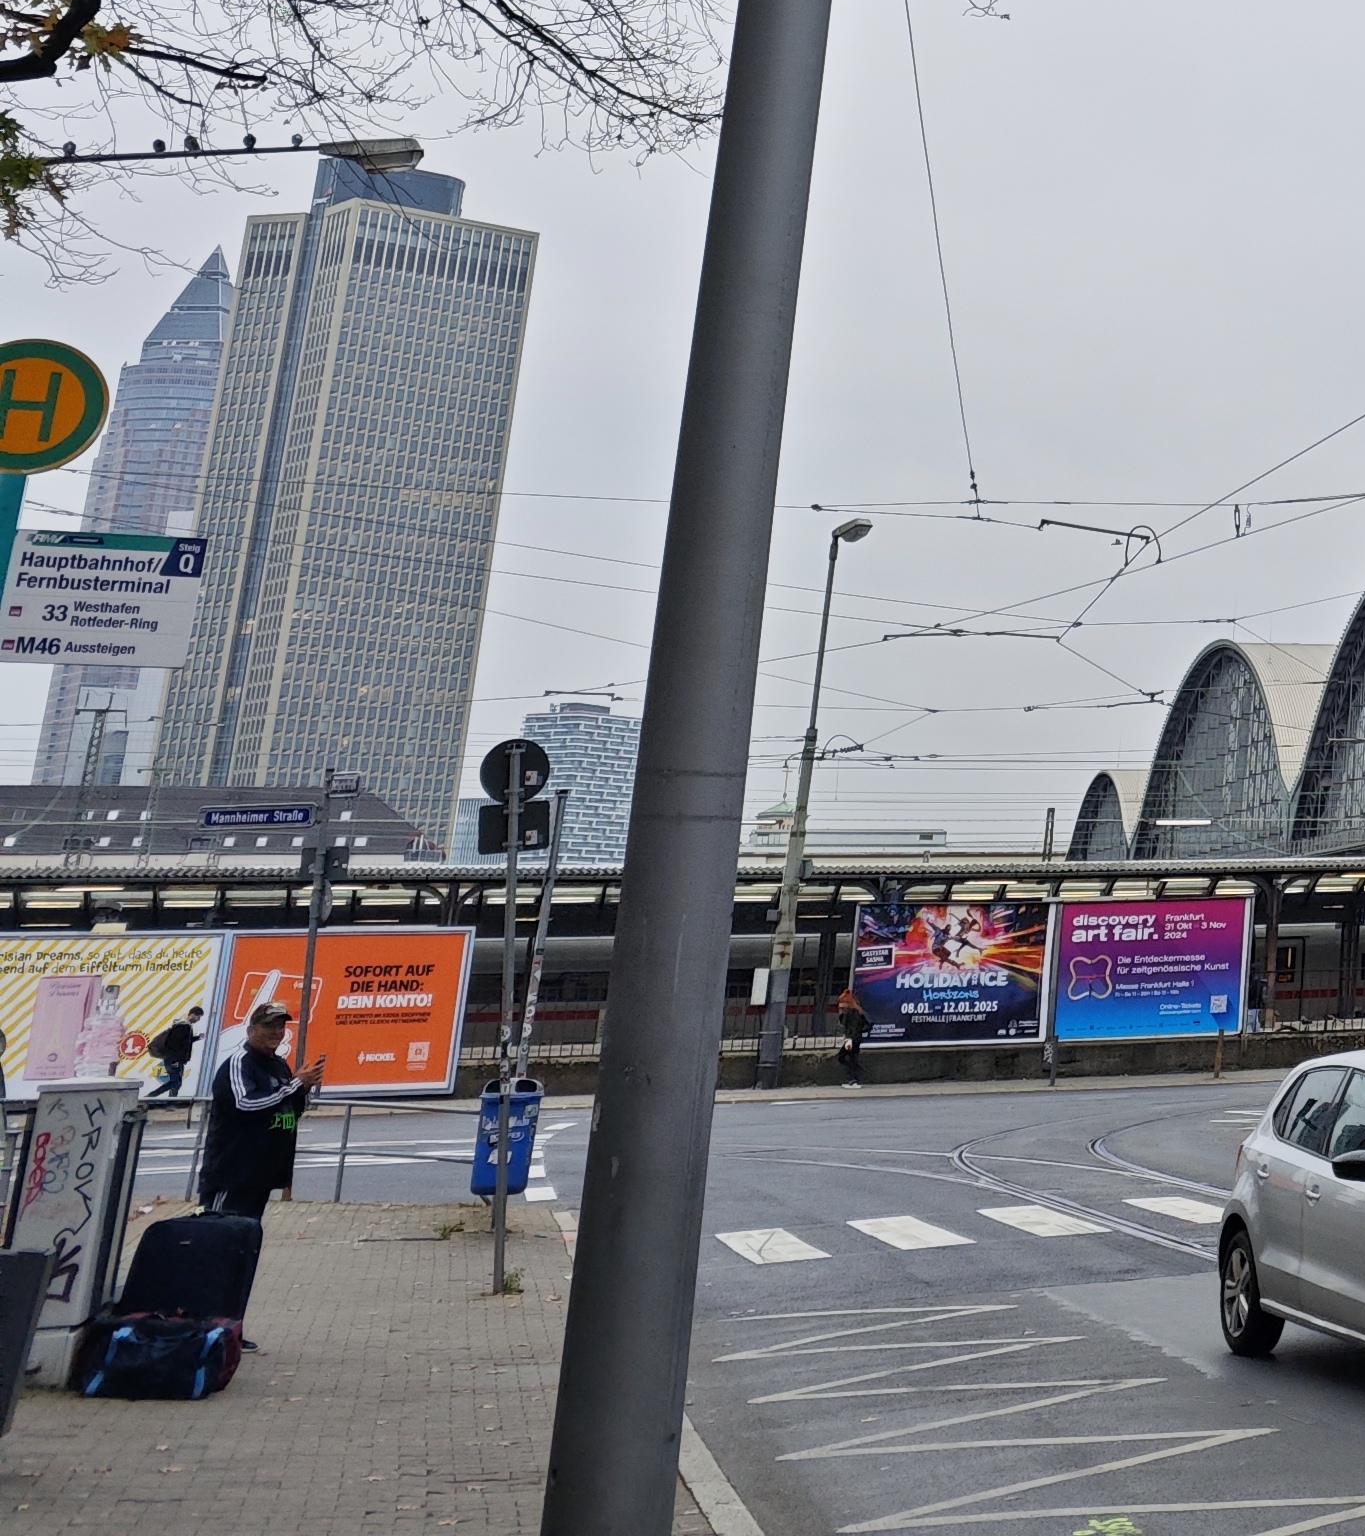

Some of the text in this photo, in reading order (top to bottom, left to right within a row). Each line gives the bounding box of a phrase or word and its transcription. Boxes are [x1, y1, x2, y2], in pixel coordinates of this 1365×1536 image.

[0, 369, 62, 442] H
[178, 543, 201, 553] Steig
[20, 551, 162, 574] Hauptbahnhof/
[178, 554, 194, 574] Q
[16, 572, 171, 594] Fernbusterminal
[42, 604, 69, 622] 33
[73, 601, 140, 615] Westhafen
[15, 636, 61, 656] M46
[64, 643, 136, 657] Aussteigen
[211, 810, 304, 824] Mannheimer Straße
[1072, 914, 1156, 926] discovery
[1165, 913, 1205, 922] Frankfurt
[1177, 922, 1192, 930] Okt
[1201, 922, 1207, 930] 3
[1209, 921, 1227, 929] Nov
[1071, 924, 1158, 942] art fair.
[1164, 932, 1187, 940] 2024
[37, 951, 84, 961] Dreams,
[87, 952, 100, 960] so
[129, 948, 153, 960] dass
[156, 948, 169, 959] du
[172, 948, 203, 958] heute
[1117, 954, 1205, 964] Die Entdeckermesse
[28, 962, 49, 974] auf
[51, 962, 76, 974] dem
[80, 960, 142, 973] Eiffelturm
[146, 959, 193, 972] landest!
[344, 964, 435, 978] SOFORT AUF
[1117, 962, 1229, 975] für zeitgenössische Kunst
[350, 979, 424, 993] DIE HAND:
[895, 972, 972, 989] HOLIDAY
[980, 971, 1009, 987] ICE
[337, 994, 433, 1009] DEIN KONTO!
[901, 1002, 934, 1015] 08.01.
[943, 1001, 999, 1013] 12.01.2025
